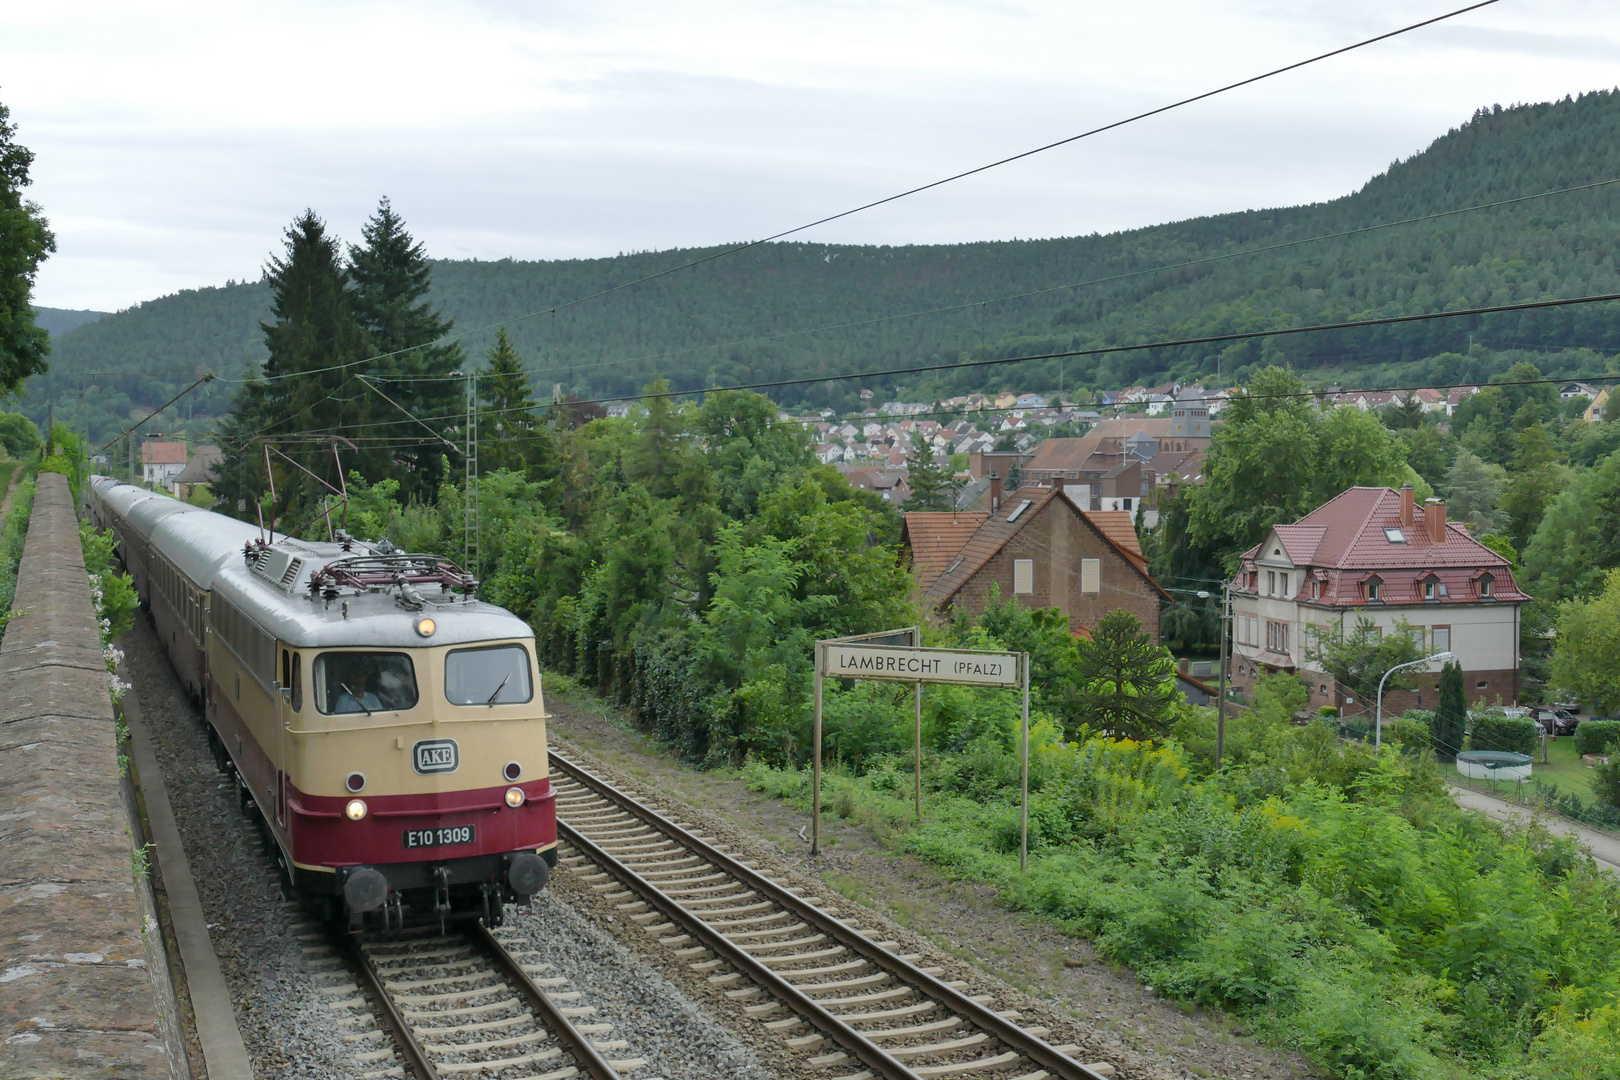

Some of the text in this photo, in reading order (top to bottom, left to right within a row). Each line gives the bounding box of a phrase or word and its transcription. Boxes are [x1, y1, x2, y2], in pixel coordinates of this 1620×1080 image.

[840, 654, 1002, 677] LAMBRECHT (PFALZ)
[422, 749, 452, 765] AKE
[408, 827, 470, 847] E10 1309
